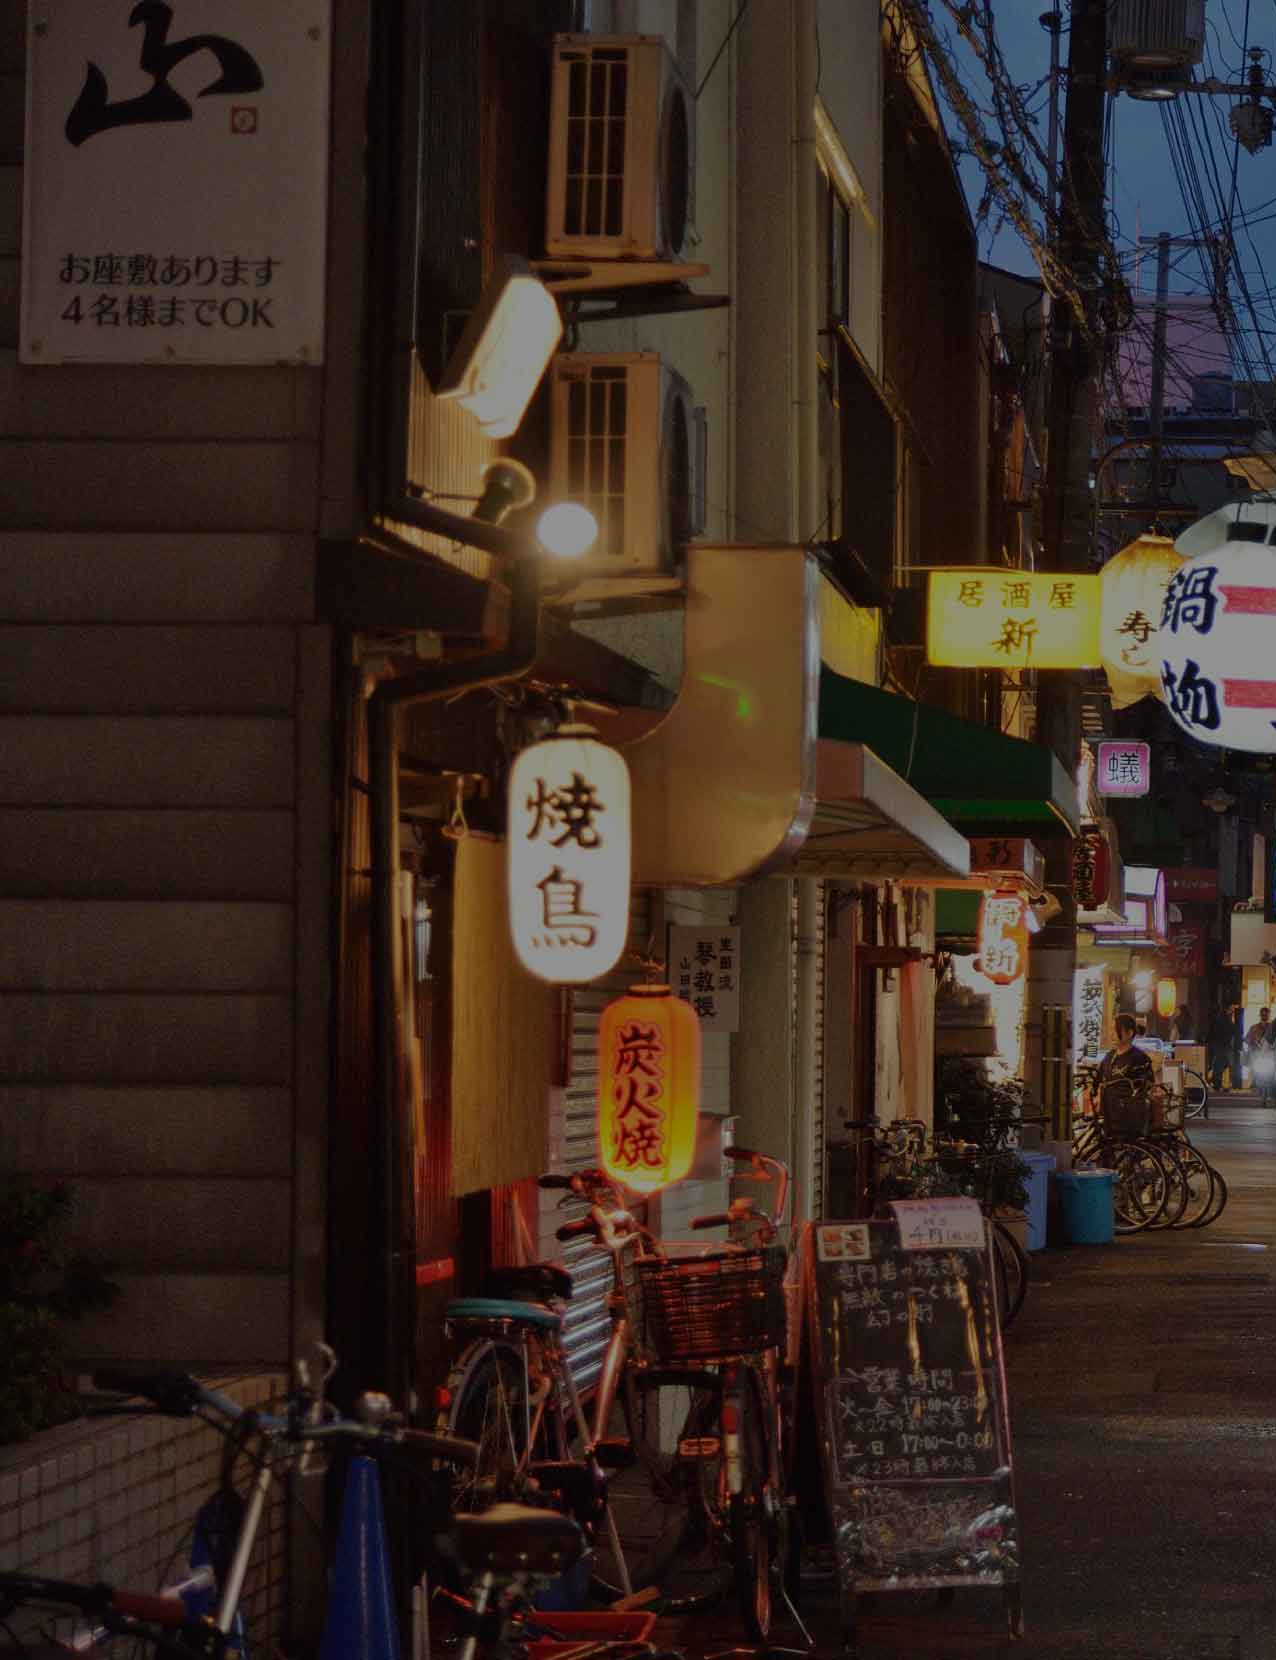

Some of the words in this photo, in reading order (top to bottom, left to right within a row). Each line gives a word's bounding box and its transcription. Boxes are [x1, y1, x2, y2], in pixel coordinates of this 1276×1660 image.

[65, 0, 264, 147] 山
[59, 252, 281, 288] お座敷あります
[957, 580, 1077, 610] 居酒屋
[991, 617, 1040, 659] 新
[526, 771, 605, 948] 焼鳥
[613, 1023, 663, 1168] 炭火焼
